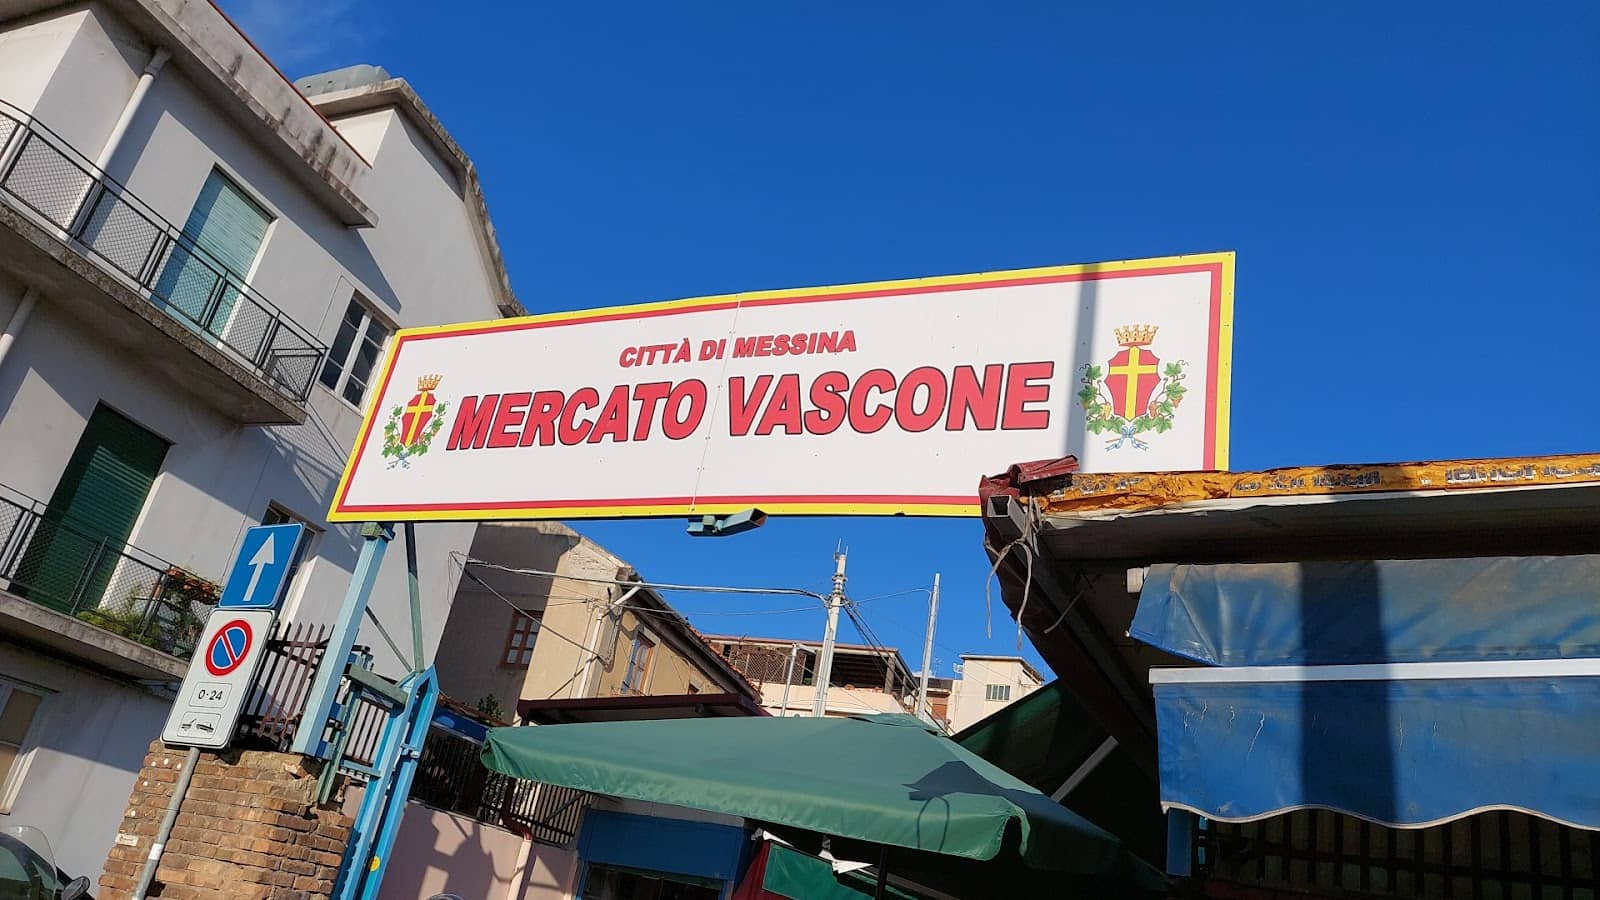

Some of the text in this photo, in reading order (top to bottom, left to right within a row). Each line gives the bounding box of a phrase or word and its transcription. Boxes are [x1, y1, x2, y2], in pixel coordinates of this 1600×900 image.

[619, 329, 857, 368] CITTÀ DI MESSINA
[446, 360, 1054, 451] MERCATO VASCONE
